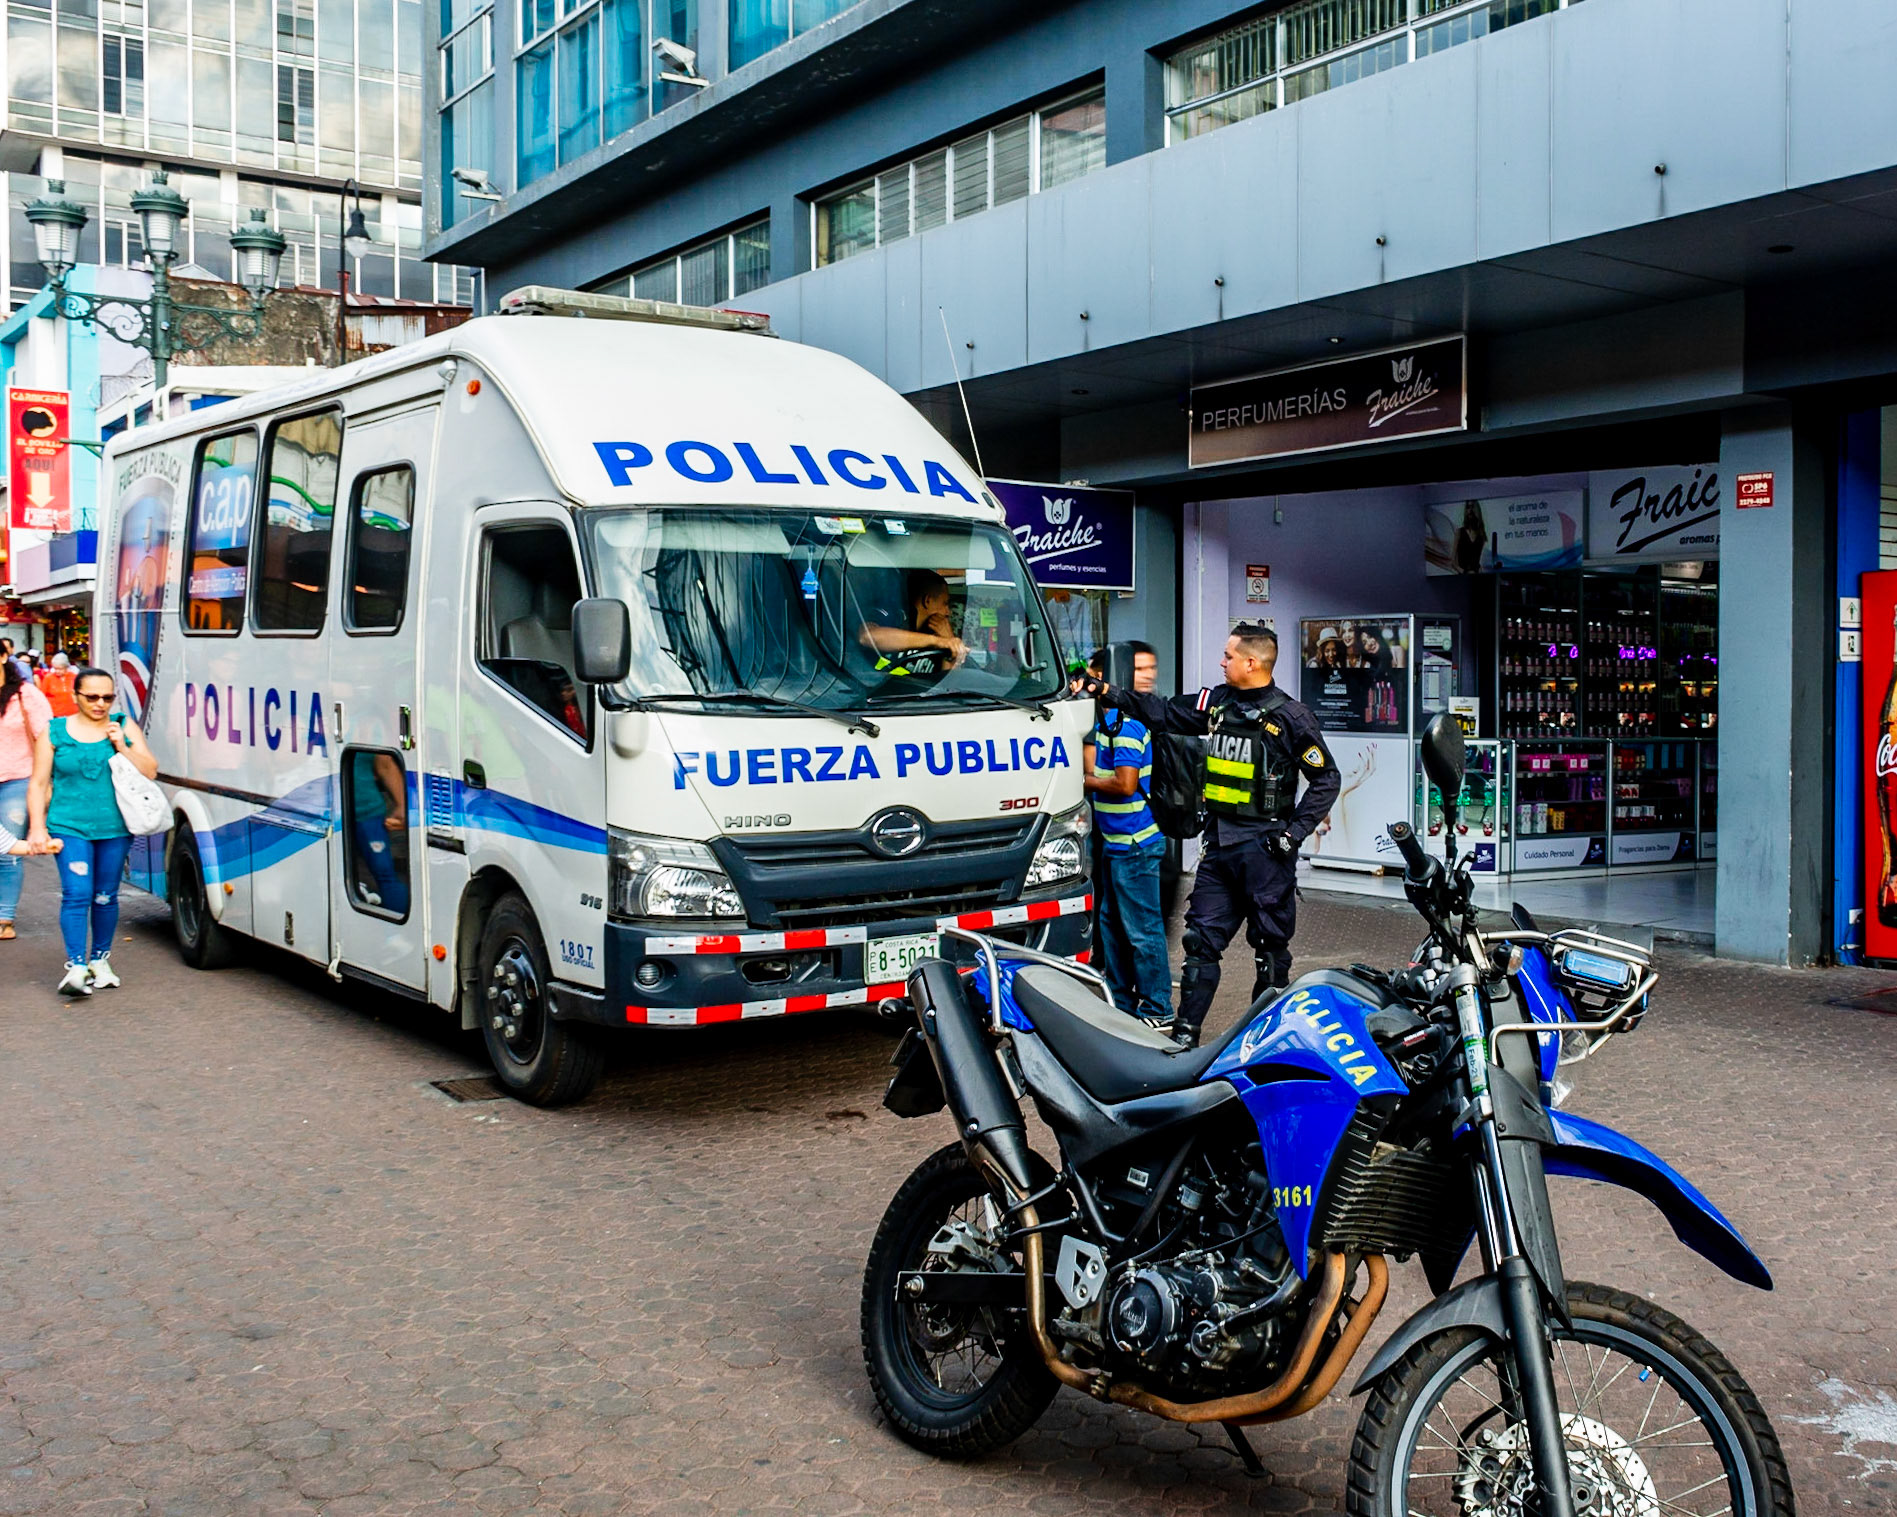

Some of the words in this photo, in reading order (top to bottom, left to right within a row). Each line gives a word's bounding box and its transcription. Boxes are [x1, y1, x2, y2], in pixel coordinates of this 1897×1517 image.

[1366, 368, 1432, 424] Fraiche
[1202, 388, 1348, 432] PERFUMERÍAS
[592, 440, 979, 505] POLICIA
[1516, 503, 1537, 512] aroma
[1610, 468, 1720, 547] Fraic
[1012, 515, 1095, 552] Fraiche
[1680, 534, 1714, 545] aromas
[1049, 563, 1076, 572] perfumes
[1083, 565, 1106, 573] esencias
[185, 682, 328, 758] POLICIA
[1208, 734, 1252, 763] OLICIA
[673, 744, 881, 790] FUERZA
[895, 736, 1071, 778] PUBLICA
[999, 796, 1040, 811] 300
[724, 813, 792, 829] HINO
[1524, 850, 1549, 859] Cuidado
[1549, 849, 1575, 858] Personal
[560, 939, 593, 960] 1807
[885, 940, 904, 948] COSTA
[1290, 990, 1378, 1086] POLICIA
[1273, 1184, 1312, 1208] 3161
